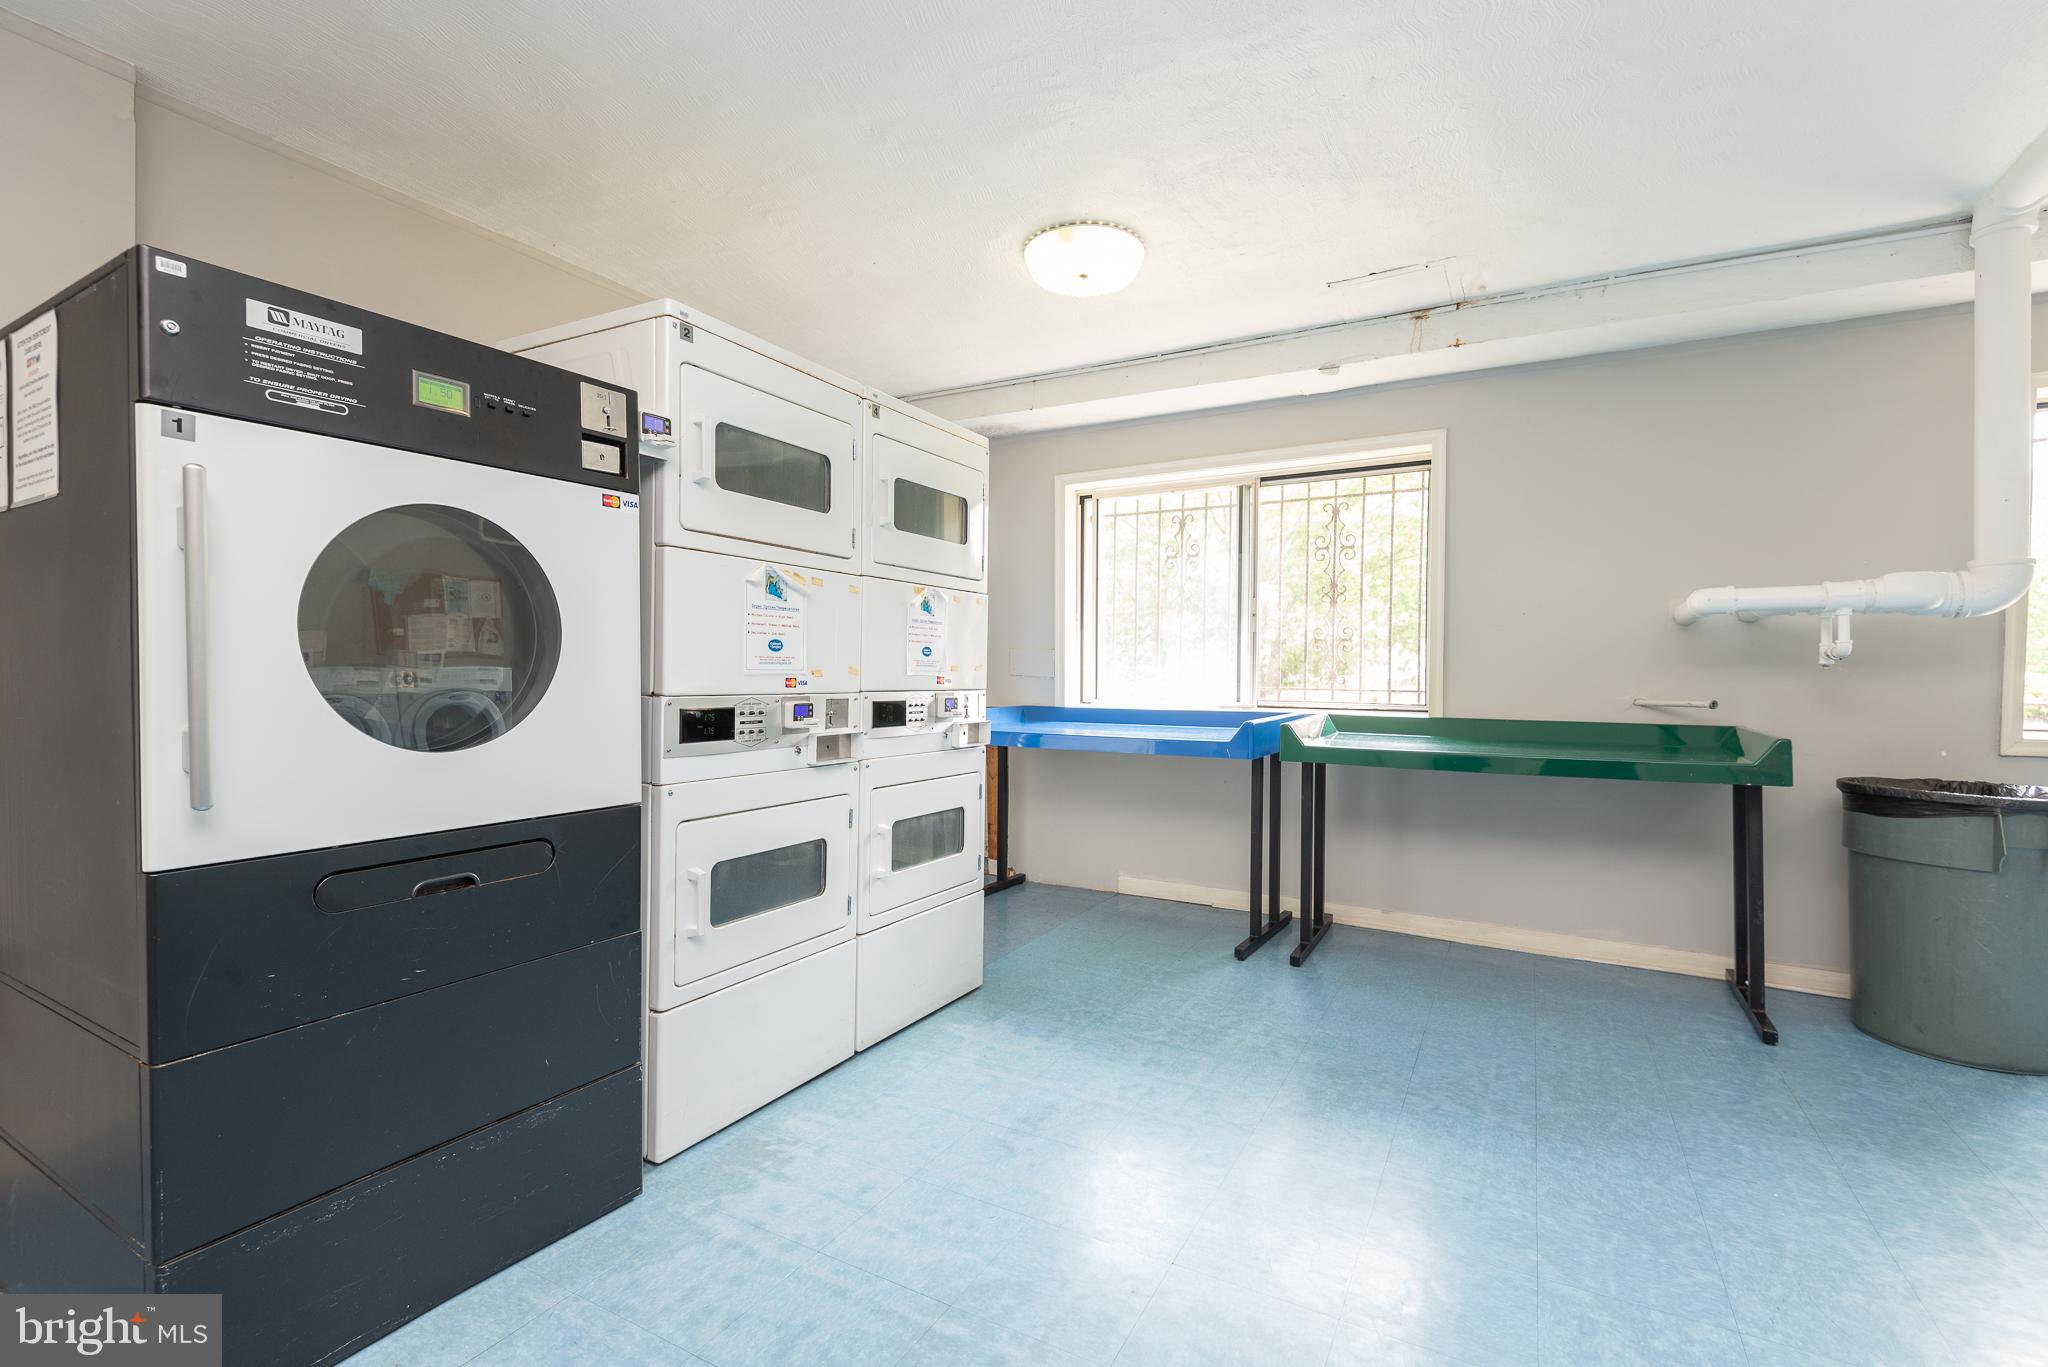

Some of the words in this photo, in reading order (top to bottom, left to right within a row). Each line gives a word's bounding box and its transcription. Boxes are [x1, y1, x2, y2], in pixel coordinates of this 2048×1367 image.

[272, 327, 317, 342] COMMERCIAL
[292, 317, 345, 339] MAYTAG
[684, 327, 691, 339] 2
[250, 351, 269, 359] PRESS
[254, 336, 301, 350] OPERATING
[302, 347, 357, 365] INSTRUCTIONS
[262, 379, 296, 390] ENSURE
[296, 386, 329, 398] PROPER
[329, 394, 358, 404] DRYING
[873, 407, 878, 416] 4
[171, 417, 183, 433] 1
[622, 500, 639, 509] VISA
